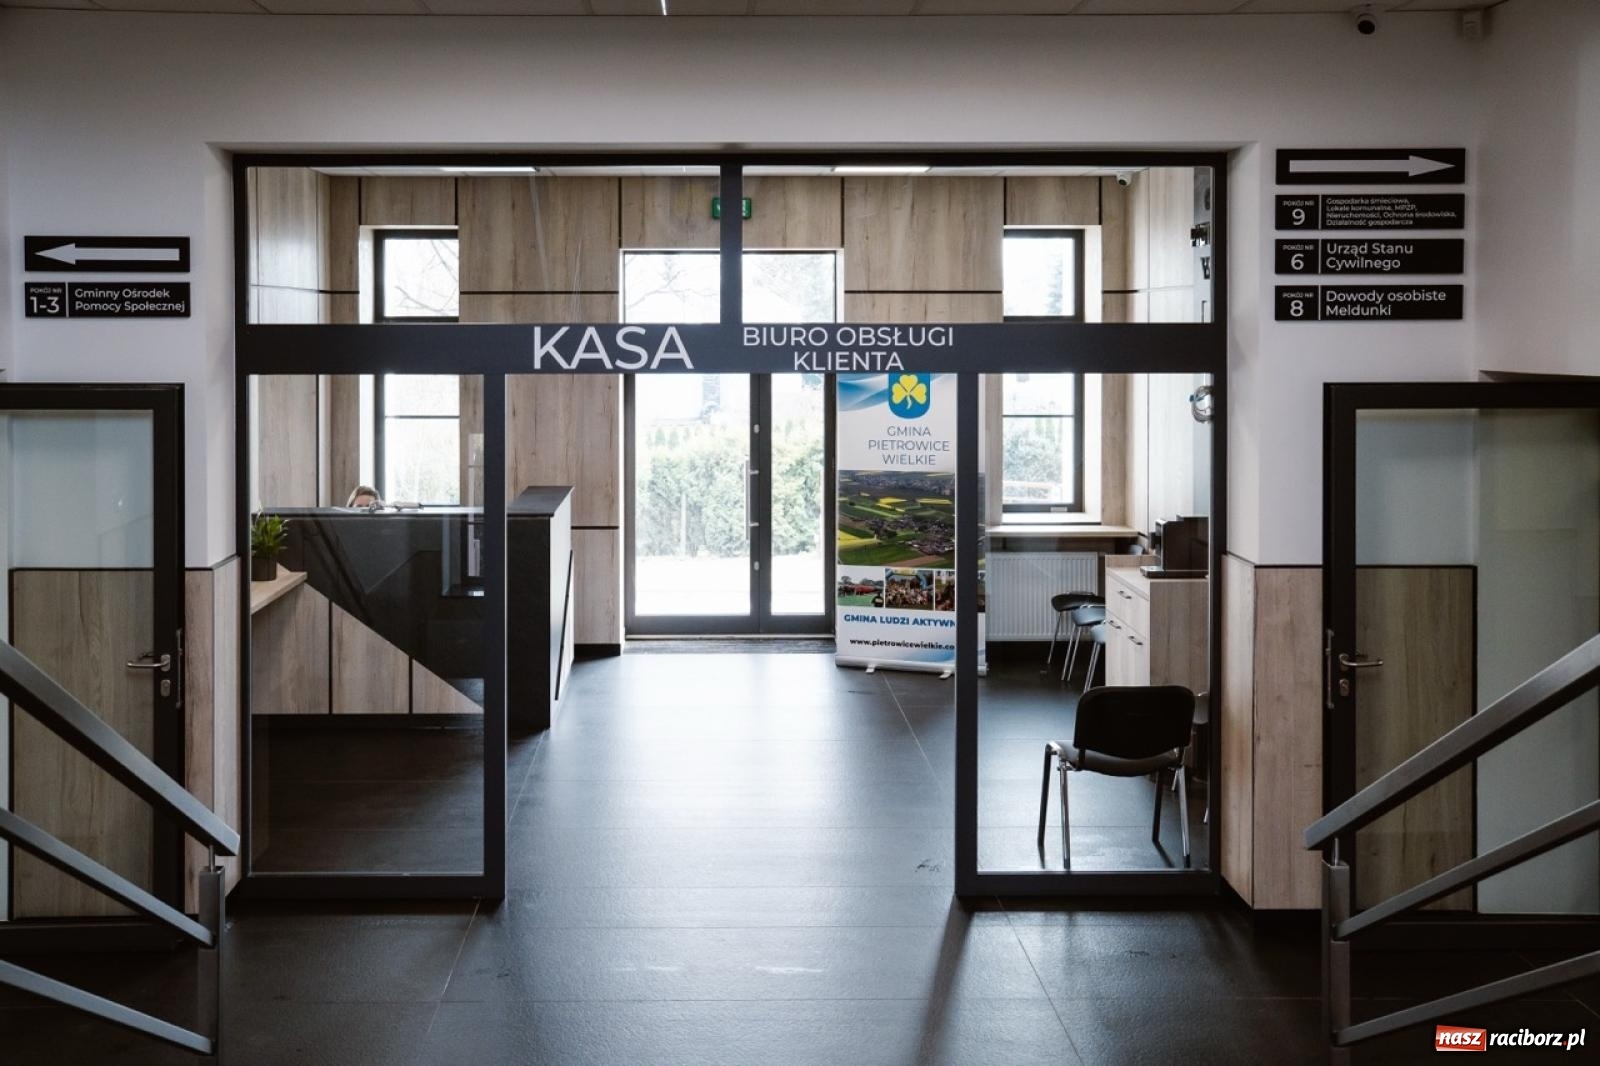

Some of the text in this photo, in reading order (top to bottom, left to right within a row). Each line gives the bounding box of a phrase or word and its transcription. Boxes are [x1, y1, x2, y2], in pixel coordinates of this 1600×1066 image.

[1326, 198, 1368, 206] Gospodarka
[1291, 208, 1306, 226] 9
[1326, 211, 1381, 219] Nieruchomości,
[1326, 218, 1413, 227] Działalność gospodarcza
[1326, 243, 1414, 257] Urząd Stanu
[1290, 253, 1305, 271] 6
[1326, 257, 1401, 271] Cywilnego
[74, 286, 170, 300] Gminny Ośrodek
[1326, 290, 1447, 304] Dowody osobiste
[29, 296, 60, 314] 1-3
[75, 301, 185, 313] Pomocy Społecznej
[1290, 299, 1304, 317] 8
[1326, 304, 1391, 316] Meldunki
[743, 326, 954, 346] BIURO OBSŁUGI
[533, 326, 694, 369] KASA
[794, 351, 904, 371] KLIENTA
[887, 426, 931, 436] GMINA
[868, 440, 950, 451] PIETROWICE
[883, 454, 936, 465] WIELKIE
[844, 614, 877, 623] GMINA
[880, 616, 909, 625] LUDZI
